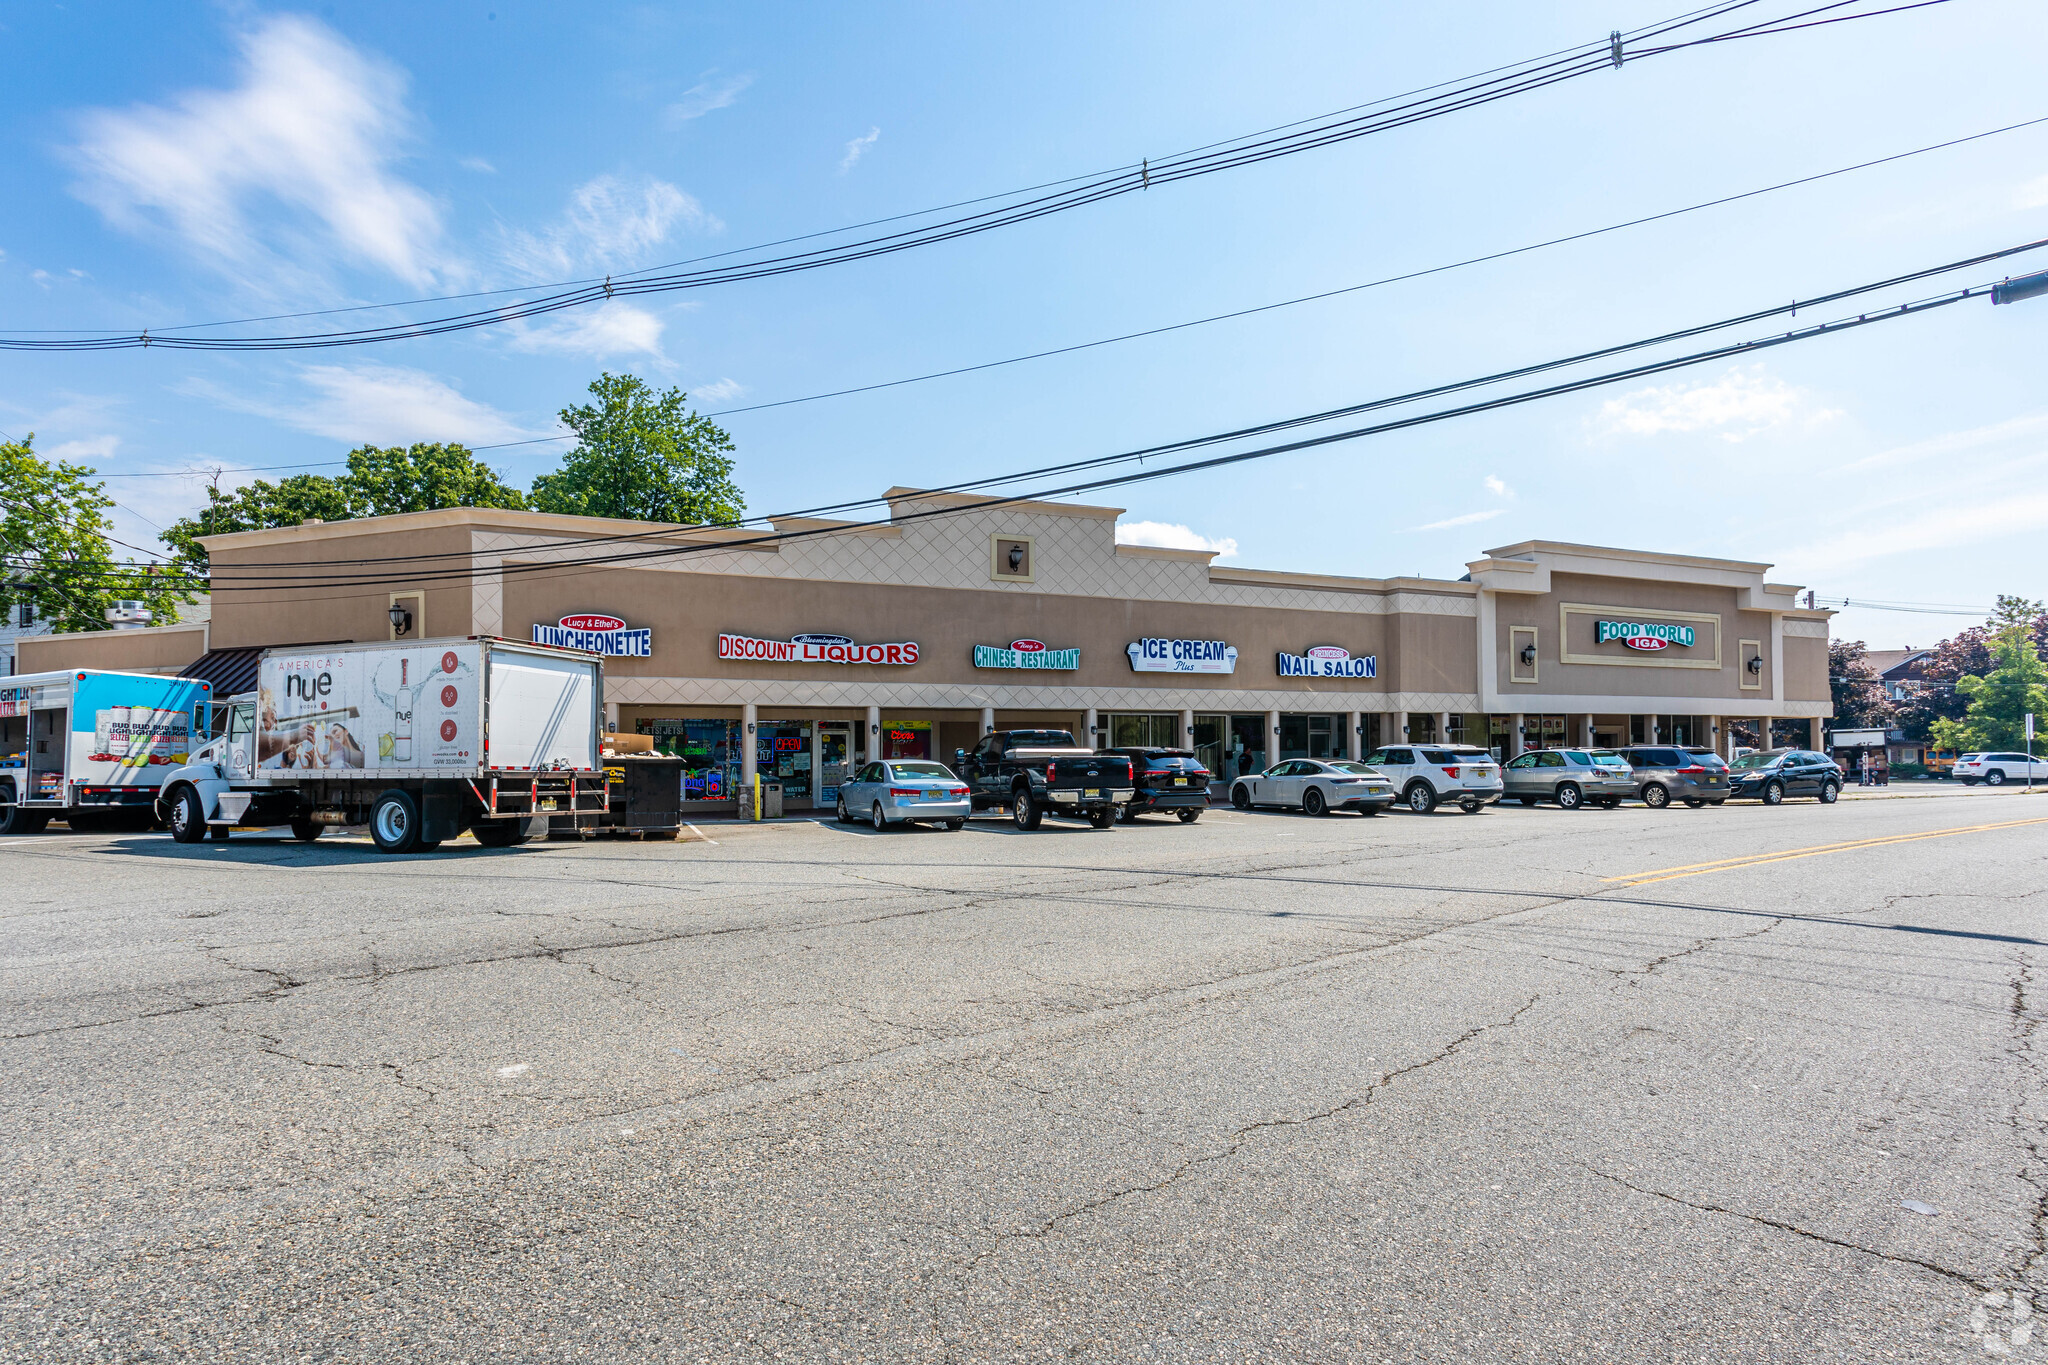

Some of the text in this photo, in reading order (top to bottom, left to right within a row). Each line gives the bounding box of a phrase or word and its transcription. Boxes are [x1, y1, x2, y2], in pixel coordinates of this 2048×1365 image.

[567, 618, 619, 629] Lucy & Ethel's
[1600, 621, 1695, 647] FOOD WORLD
[799, 635, 848, 646] Bloomingdale
[1635, 638, 1661, 648] IGA
[719, 635, 919, 664] DISCOUNT LIQUORS
[1018, 642, 1039, 651] Ting's
[1142, 639, 1225, 661] ICE CREAM
[975, 645, 1080, 669] CHINESE RESTAURANT
[1313, 649, 1344, 659] PRINCESS
[278, 658, 344, 671] AMERICA'S
[1173, 660, 1195, 671] Plus
[1280, 653, 1376, 677] NAIL SALON
[287, 672, 332, 702] nue
[395, 710, 412, 721] nue
[641, 726, 662, 735] JETS!
[663, 726, 683, 735] JETS!
[890, 730, 915, 740] Coors
[776, 738, 801, 750] OPEN
